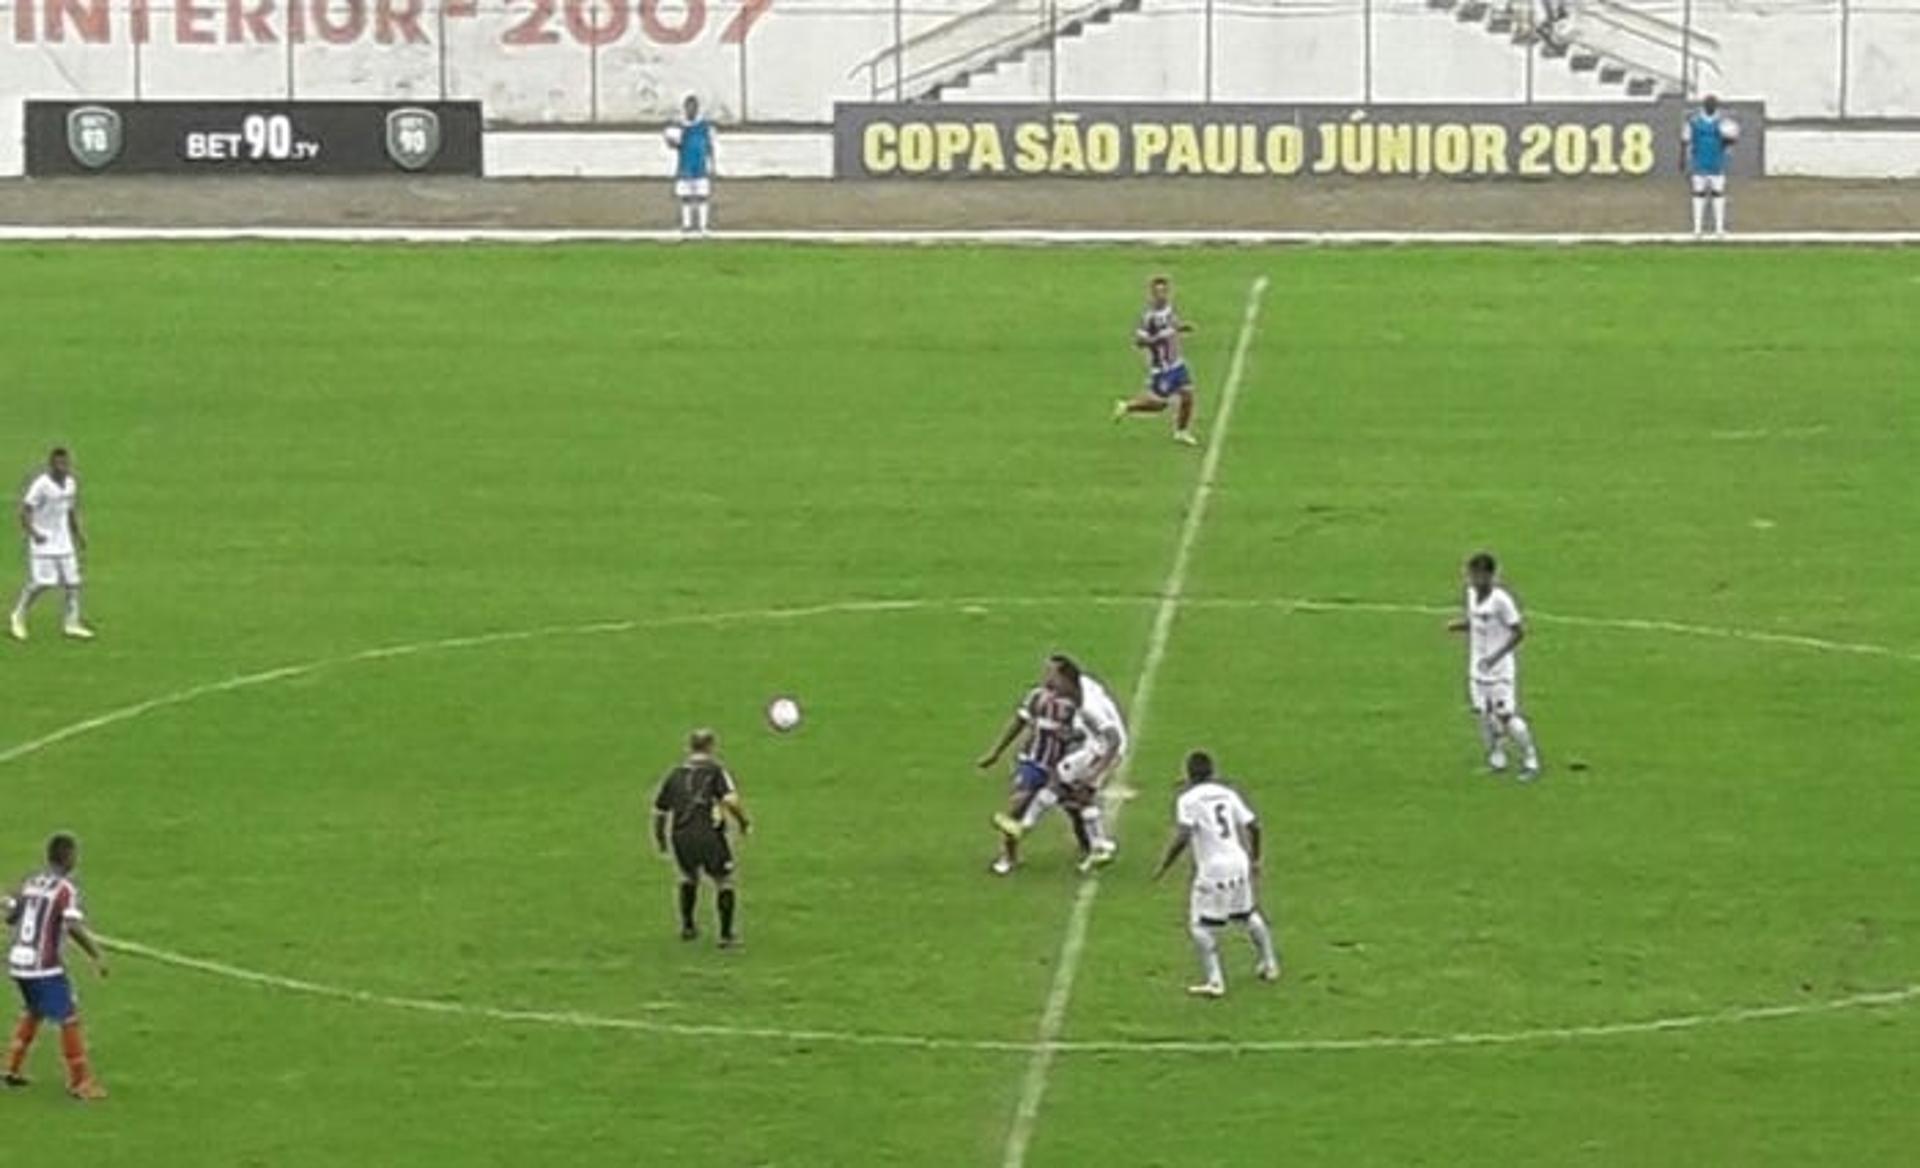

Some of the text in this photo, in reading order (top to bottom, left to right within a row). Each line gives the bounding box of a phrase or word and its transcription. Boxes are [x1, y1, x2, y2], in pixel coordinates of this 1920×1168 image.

[14, 0, 431, 45] INTERIOR
[501, 0, 774, 45] 2007
[862, 109, 1655, 175] COPA SÃO PAULO JÚNIOR 2018
[1214, 803, 1231, 839] 5
